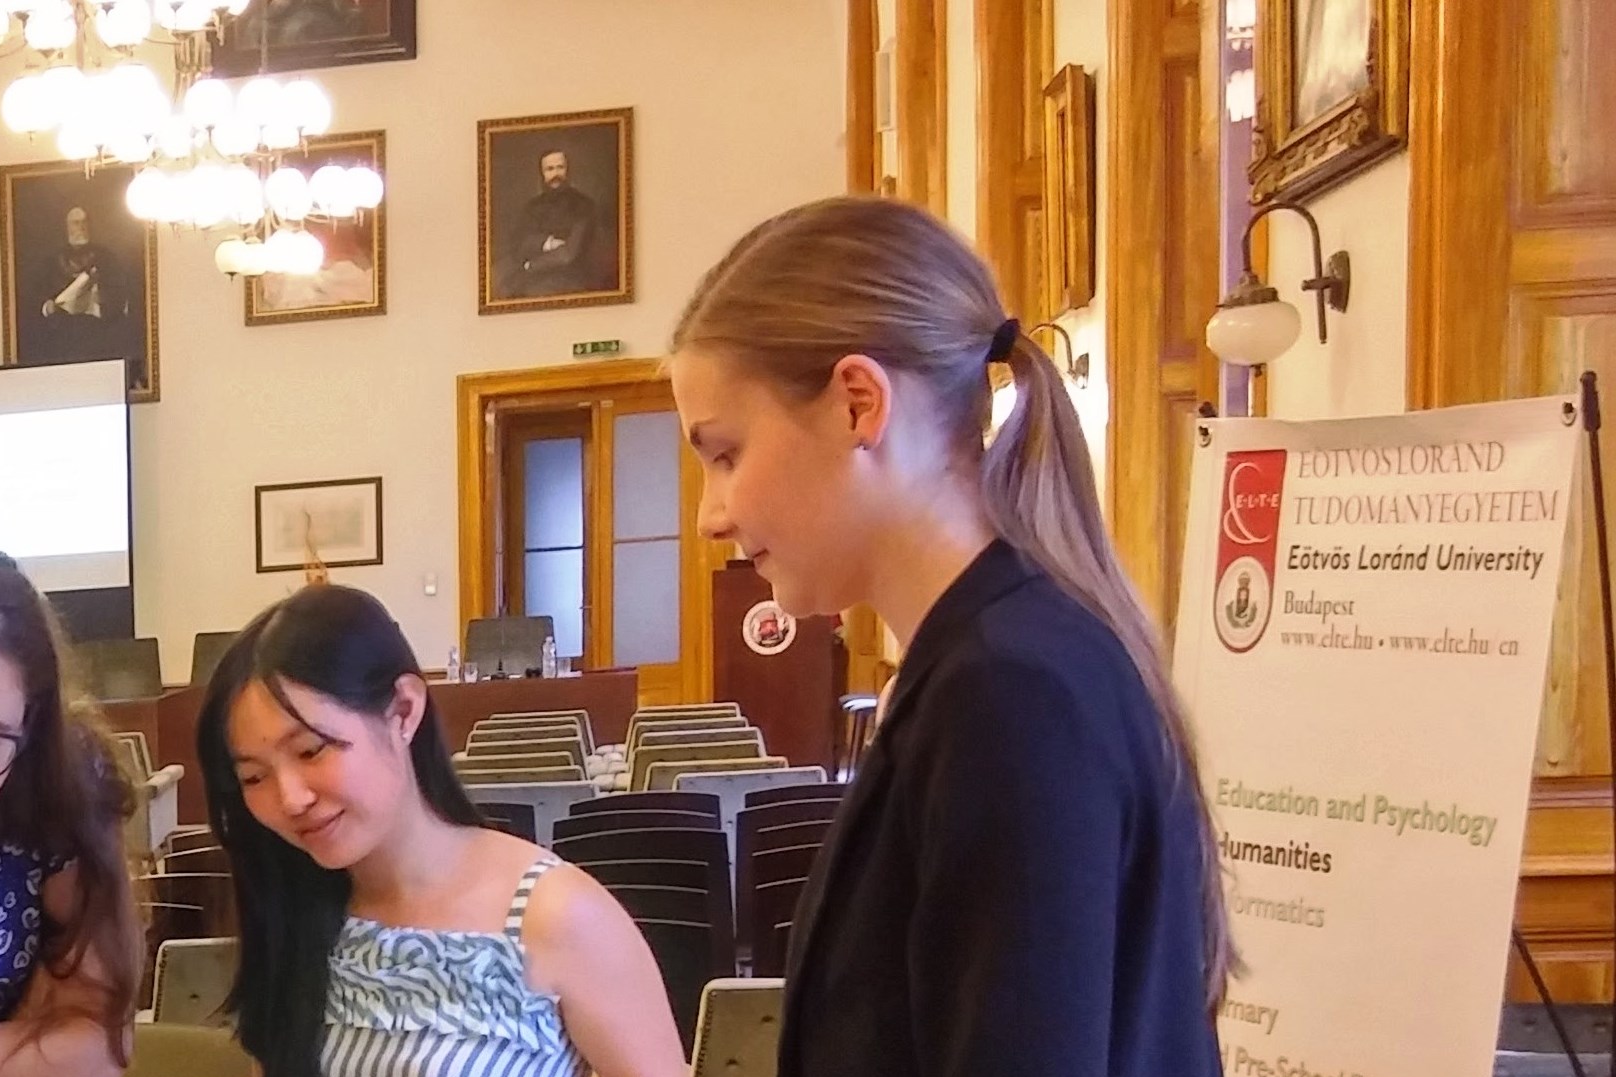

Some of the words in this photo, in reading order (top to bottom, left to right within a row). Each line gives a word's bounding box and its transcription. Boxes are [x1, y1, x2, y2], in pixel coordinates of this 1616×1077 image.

[1287, 544, 1351, 571] Eötvös
[1357, 543, 1431, 571] Loránd
[1436, 544, 1544, 580] University
[1283, 589, 1355, 625] Budapest
[1280, 623, 1373, 650] www.elte.hu
[1216, 777, 1319, 817] Education
[1327, 791, 1366, 823] and
[1371, 793, 1498, 847] Psychology
[1233, 895, 1326, 928] ormatics
